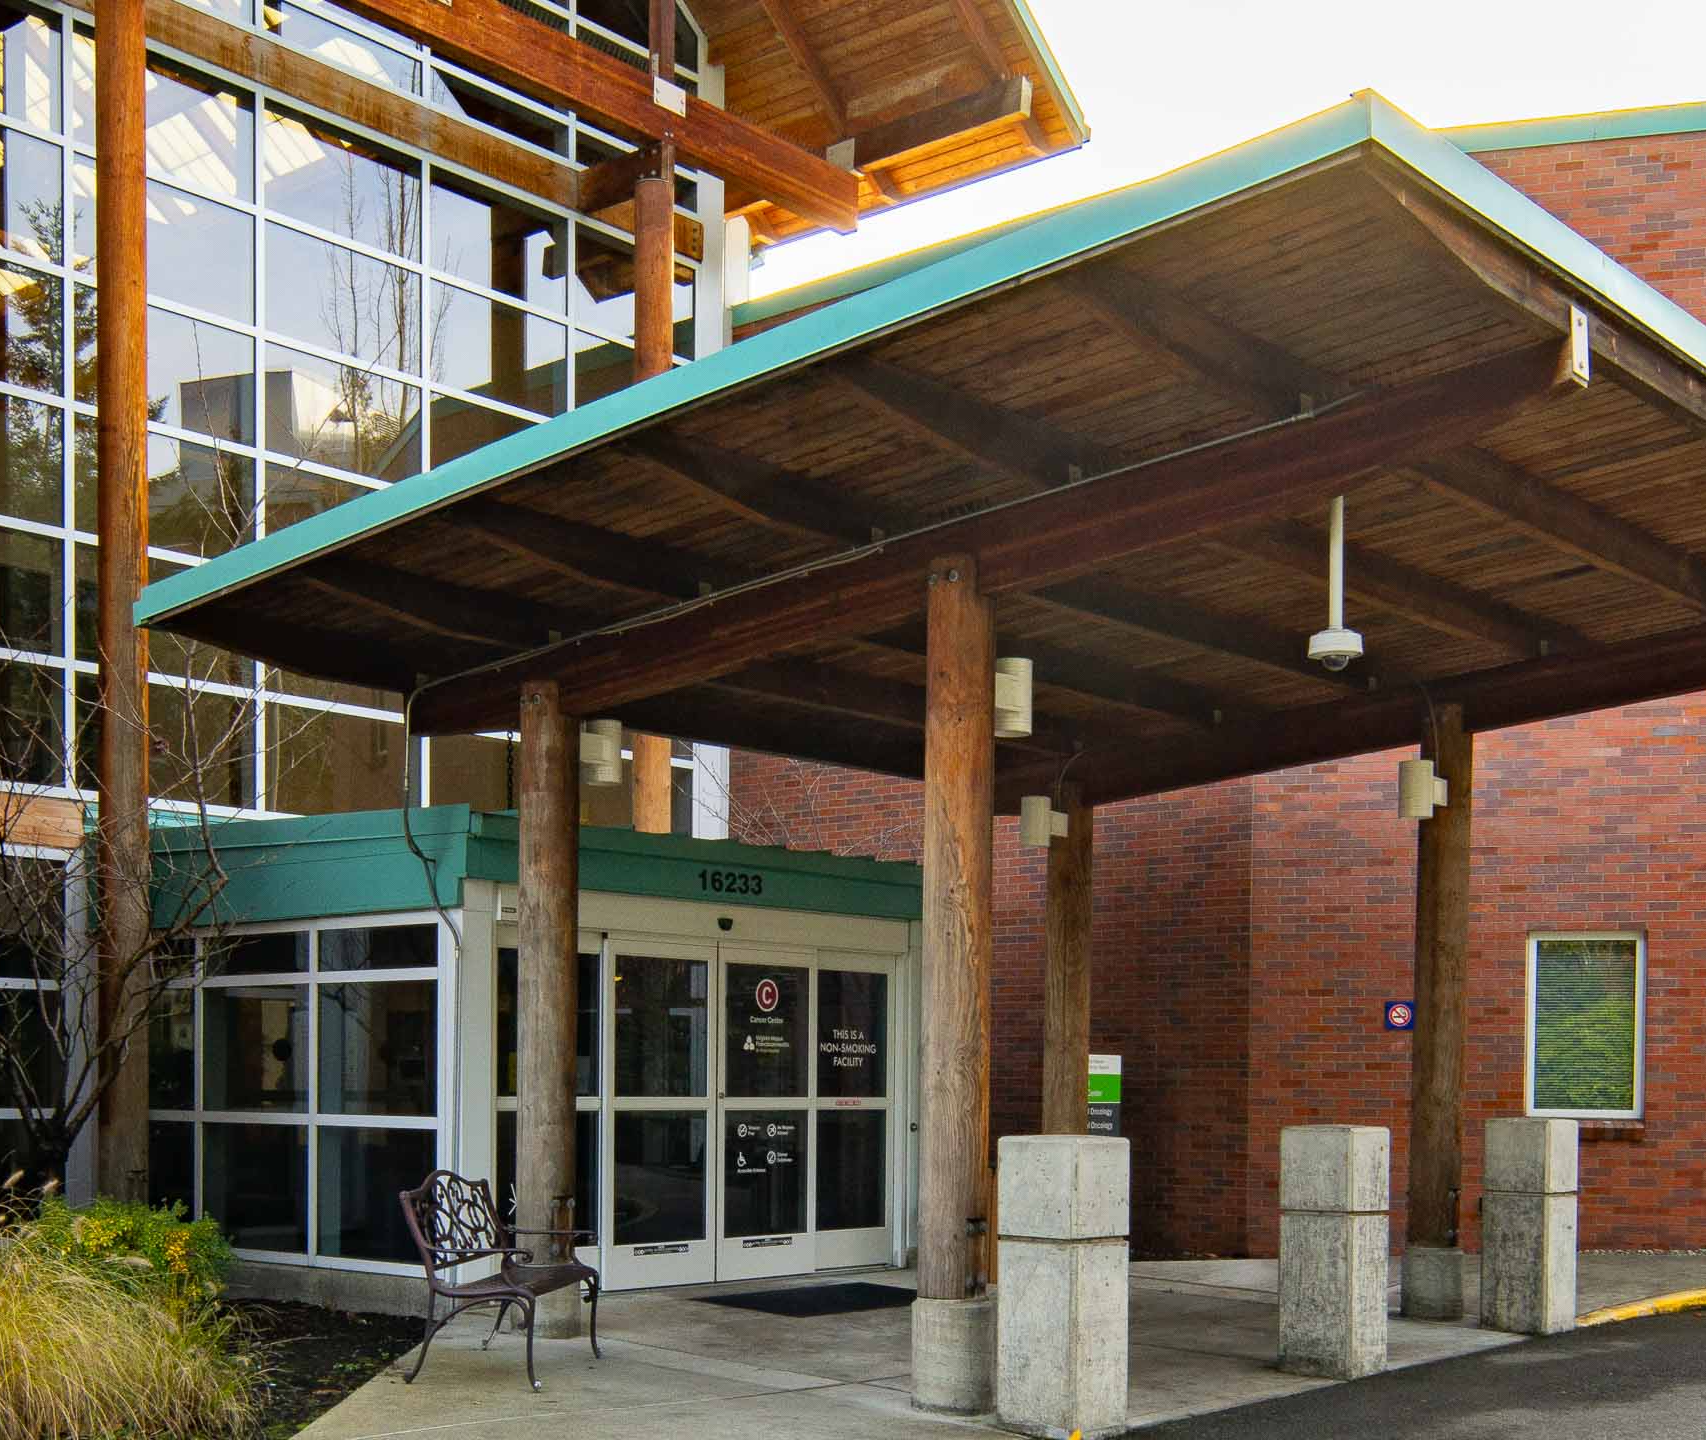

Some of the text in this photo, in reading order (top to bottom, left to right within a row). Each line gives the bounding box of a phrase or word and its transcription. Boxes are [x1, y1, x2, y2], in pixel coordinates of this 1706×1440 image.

[698, 869, 762, 895] 16233
[762, 986, 773, 1004] C
[833, 1029, 864, 1040] THIS IS A
[820, 1042, 877, 1054] NON-SMOKING
[833, 1056, 863, 1067] FACILITY
